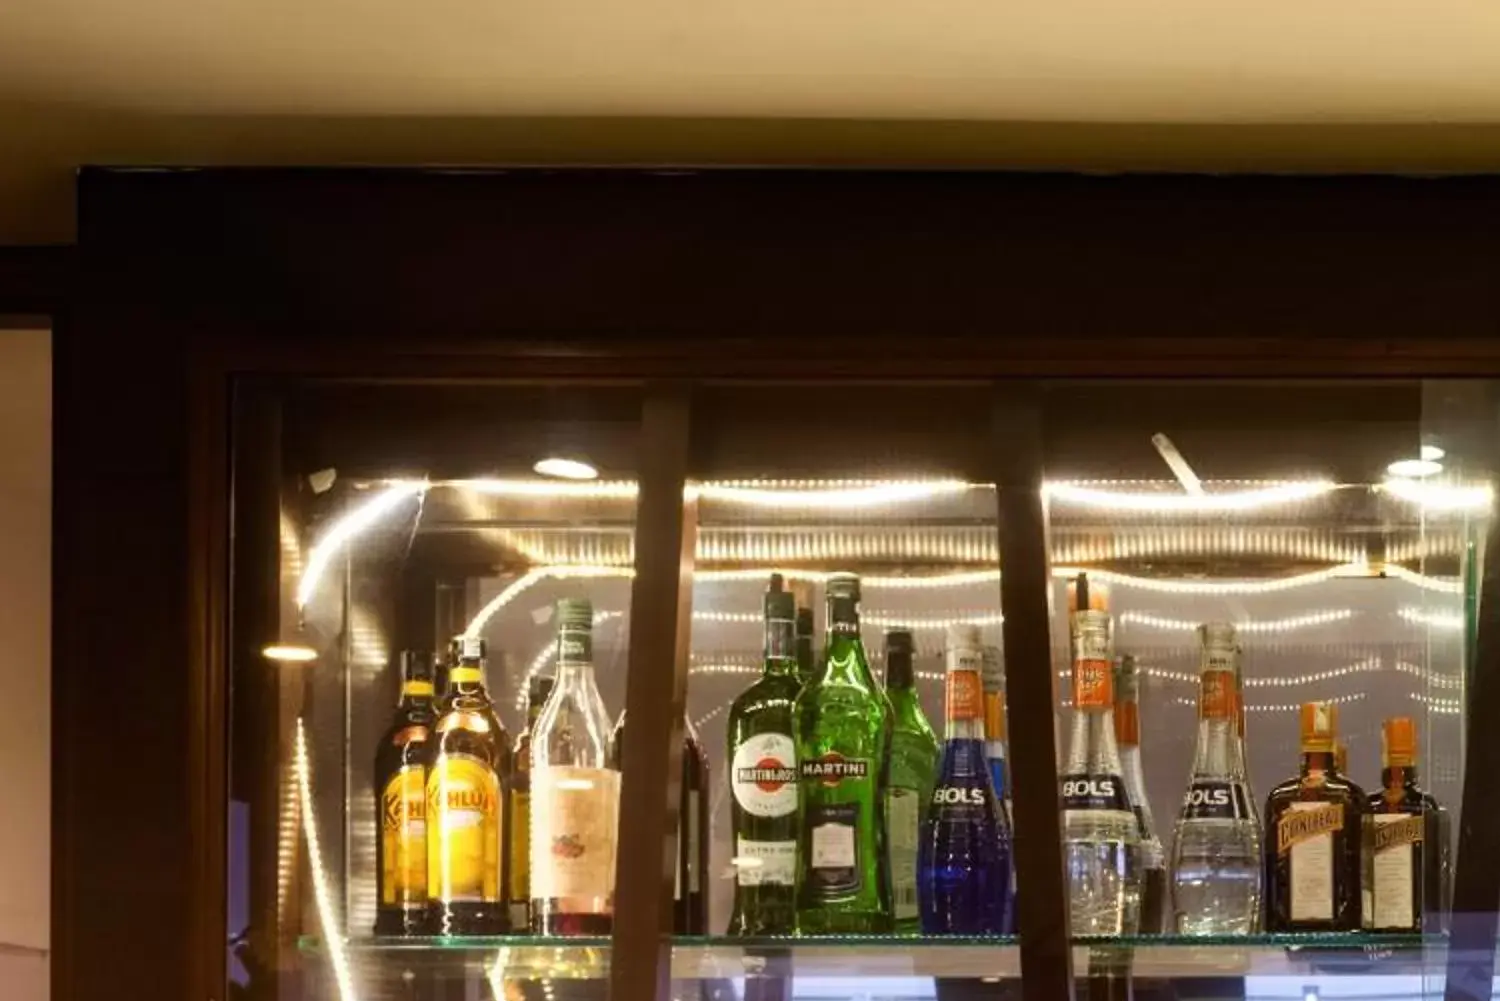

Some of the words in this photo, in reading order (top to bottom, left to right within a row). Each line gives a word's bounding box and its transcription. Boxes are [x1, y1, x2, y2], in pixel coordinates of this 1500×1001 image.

[803, 762, 866, 775] MARTINI
[934, 787, 984, 805] BOLS
[1063, 780, 1115, 797] BOLS
